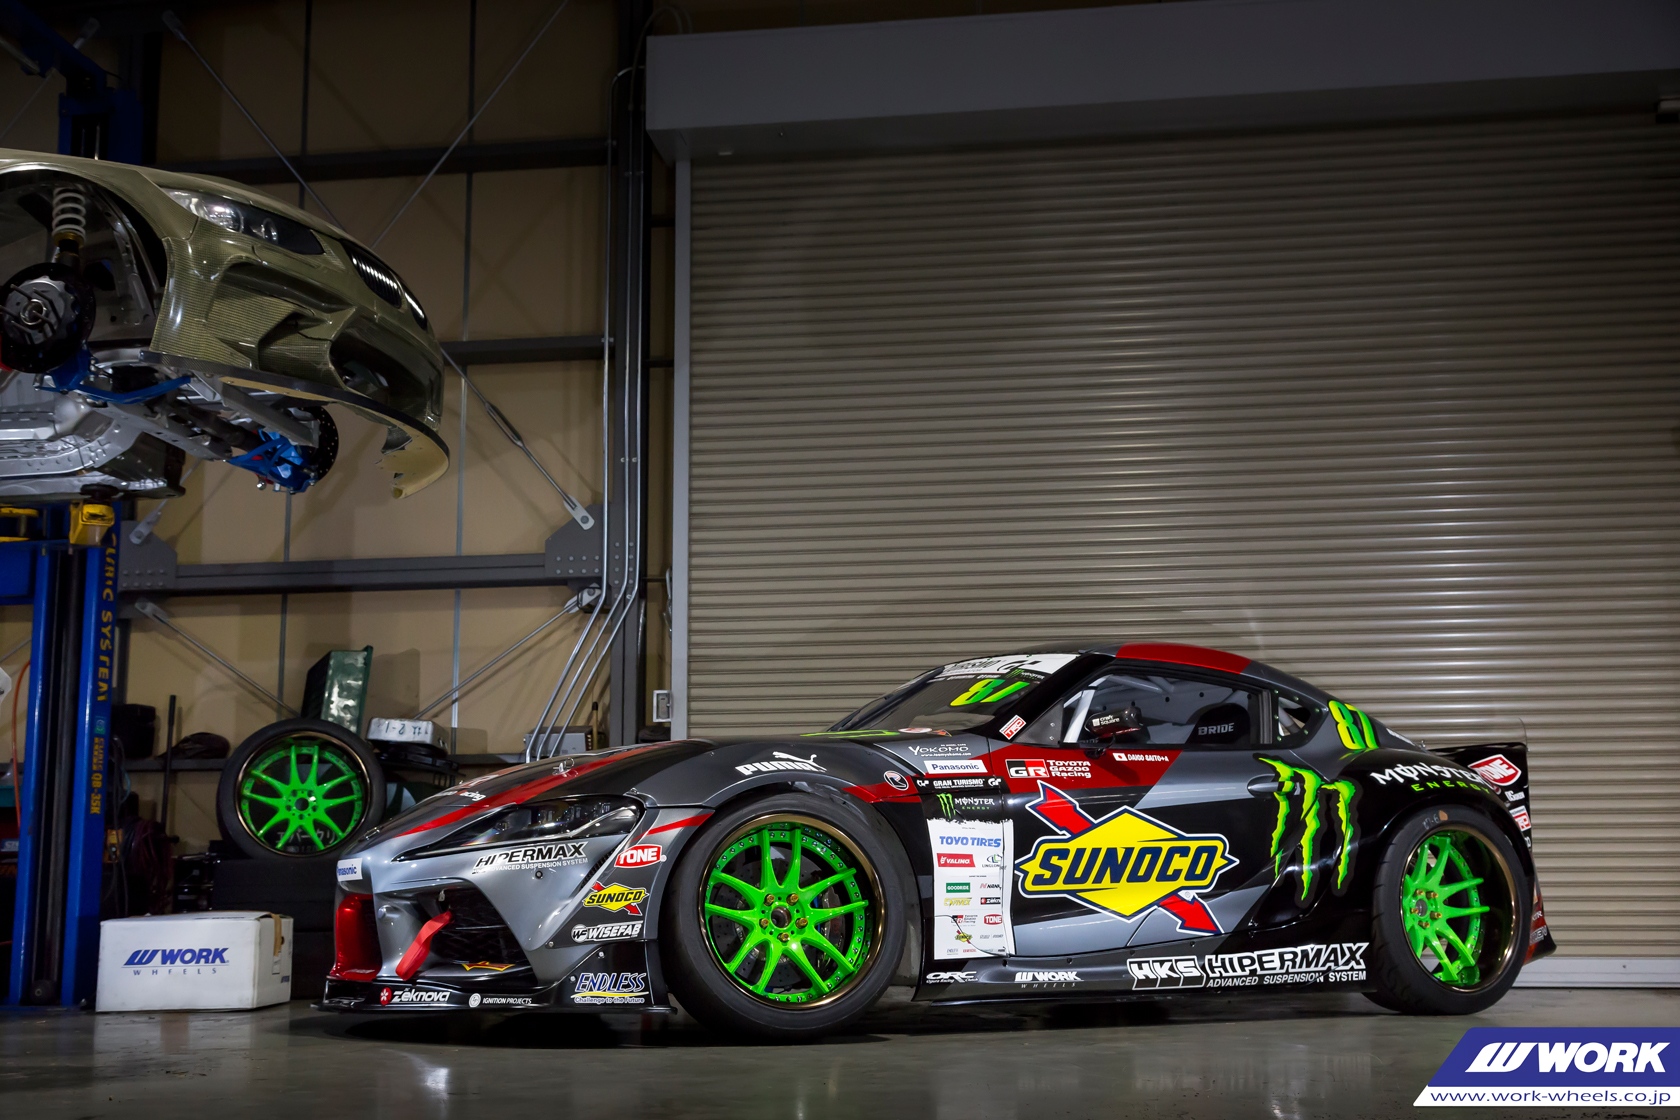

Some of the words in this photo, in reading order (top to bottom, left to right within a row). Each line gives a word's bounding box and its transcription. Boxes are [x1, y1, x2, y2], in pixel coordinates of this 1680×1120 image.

[1198, 723, 1235, 736] BRIDE
[735, 760, 821, 776] PUMA
[932, 763, 980, 773] Panasonic
[1009, 767, 1047, 777] GR
[1051, 771, 1091, 779] Racing
[1411, 780, 1490, 794] ENERGY
[954, 797, 995, 806] MONSTER
[939, 836, 970, 846] TOYO
[970, 837, 1002, 848] TIRES
[473, 841, 589, 869] HIPERMAX
[619, 848, 658, 864] TONE
[521, 861, 562, 870] SUSPENSION
[562, 857, 589, 867] SYSTEM
[1031, 845, 1219, 886] SUNOCO
[586, 891, 643, 904] SUNOCO
[985, 916, 1003, 924] TONE
[588, 924, 642, 939] WISEFAB
[159, 948, 229, 965] WORK
[1205, 942, 1370, 978] HIPERMAX
[133, 967, 217, 976] WHEELS
[1033, 971, 1083, 982] WORK
[1129, 960, 1204, 980] HKS
[574, 972, 647, 993] ENDLESS
[926, 971, 977, 983] ORC
[1206, 977, 1259, 988] ADVANCED
[1262, 973, 1325, 985] SUSPENSION
[1328, 970, 1367, 983] SYSTEM
[506, 997, 532, 1005] PROJECTS
[574, 996, 605, 1005] Challenge
